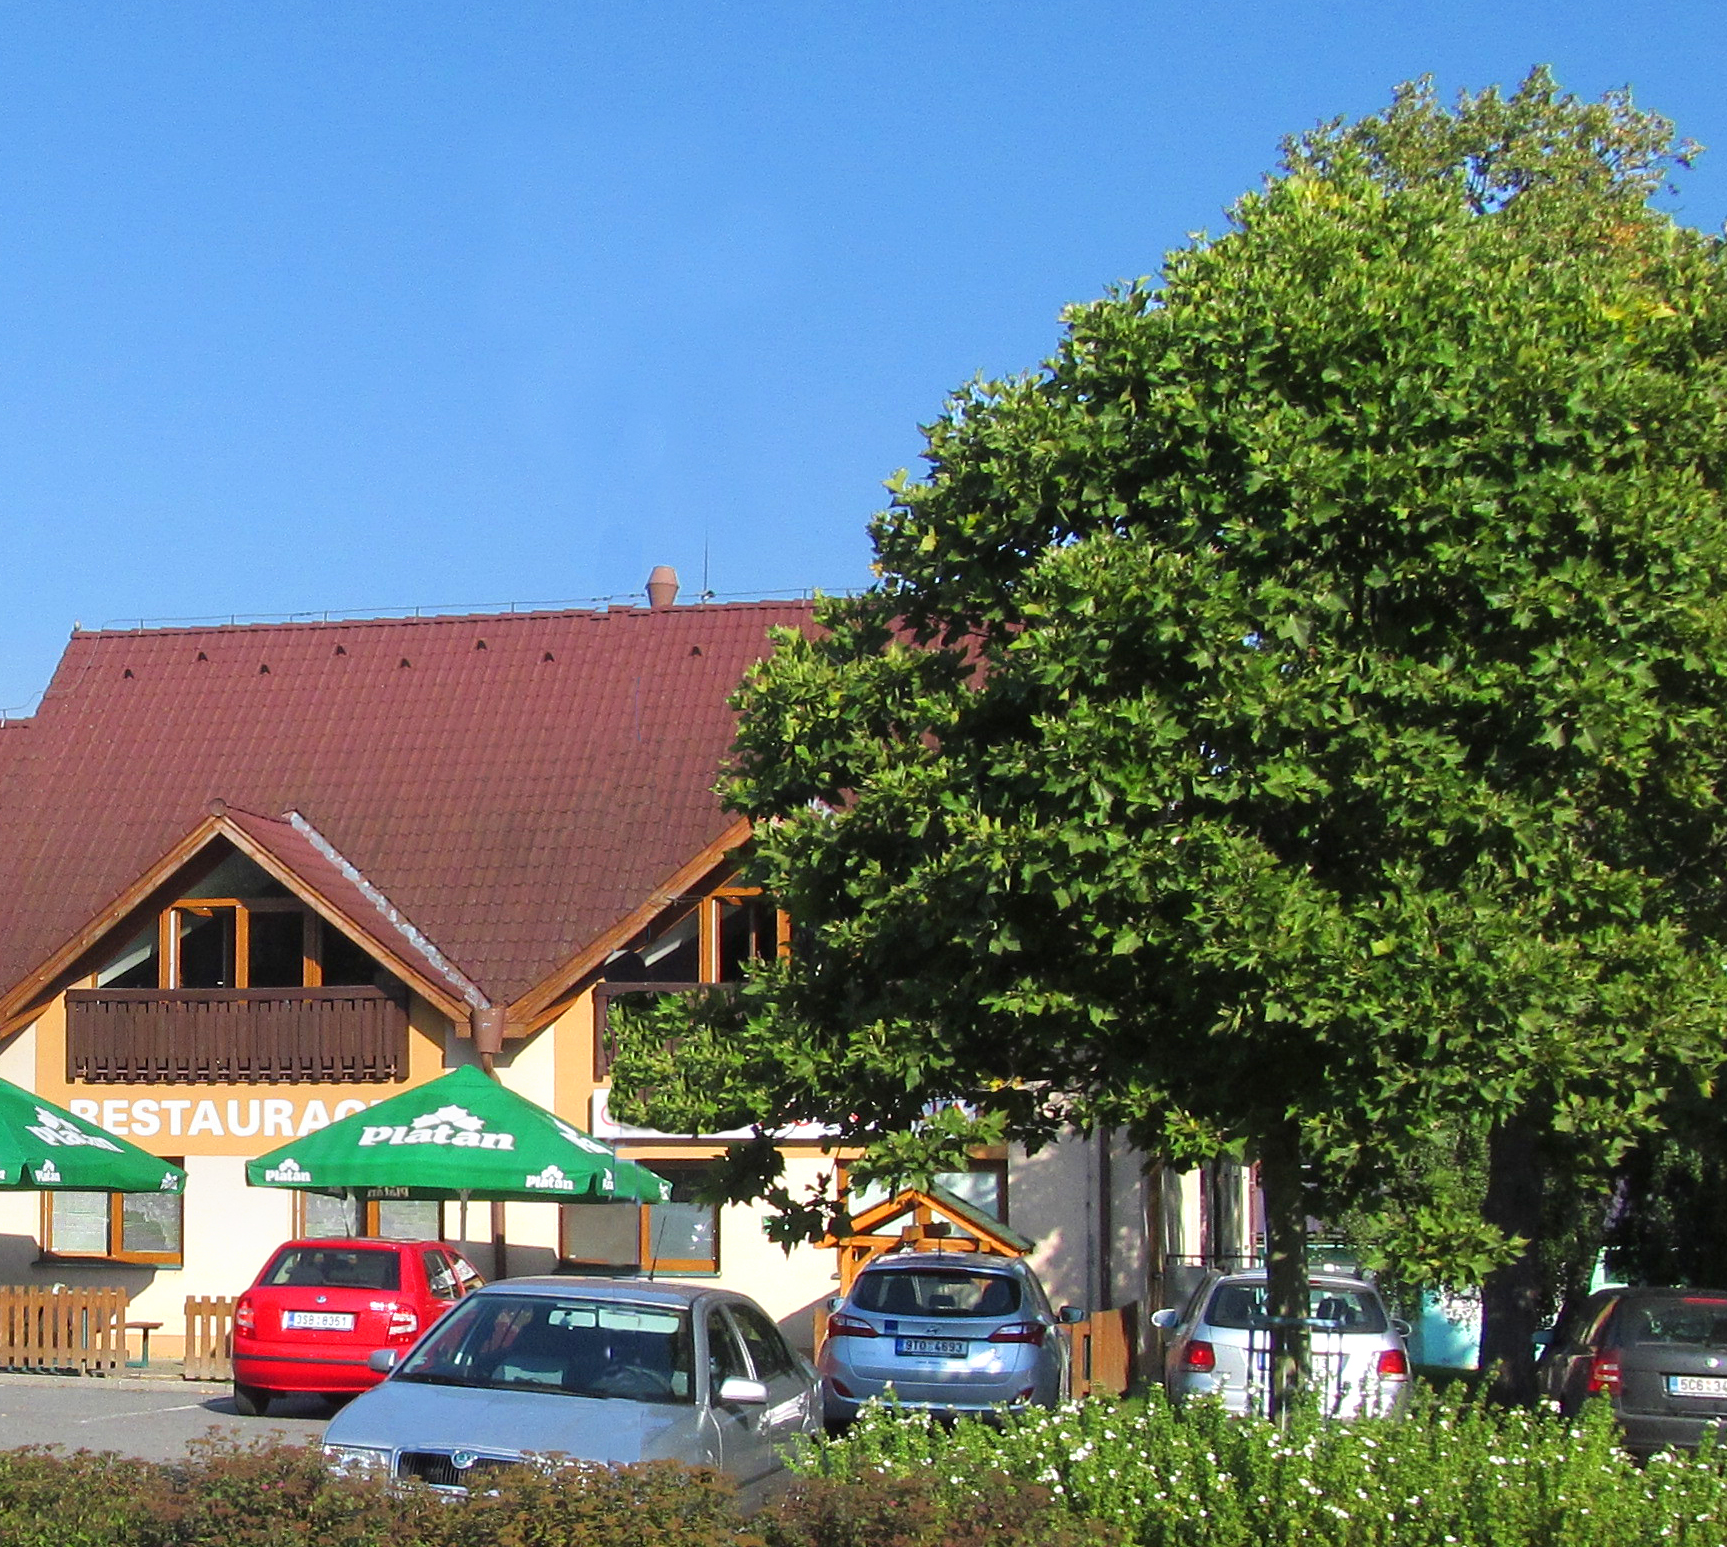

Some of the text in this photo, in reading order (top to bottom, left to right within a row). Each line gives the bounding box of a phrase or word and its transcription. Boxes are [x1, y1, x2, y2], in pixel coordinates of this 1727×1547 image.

[70, 1099, 384, 1137] RESTAURAC
[358, 1124, 514, 1150] Platan
[265, 1169, 312, 1182] Platan
[525, 1174, 574, 1190] Platan
